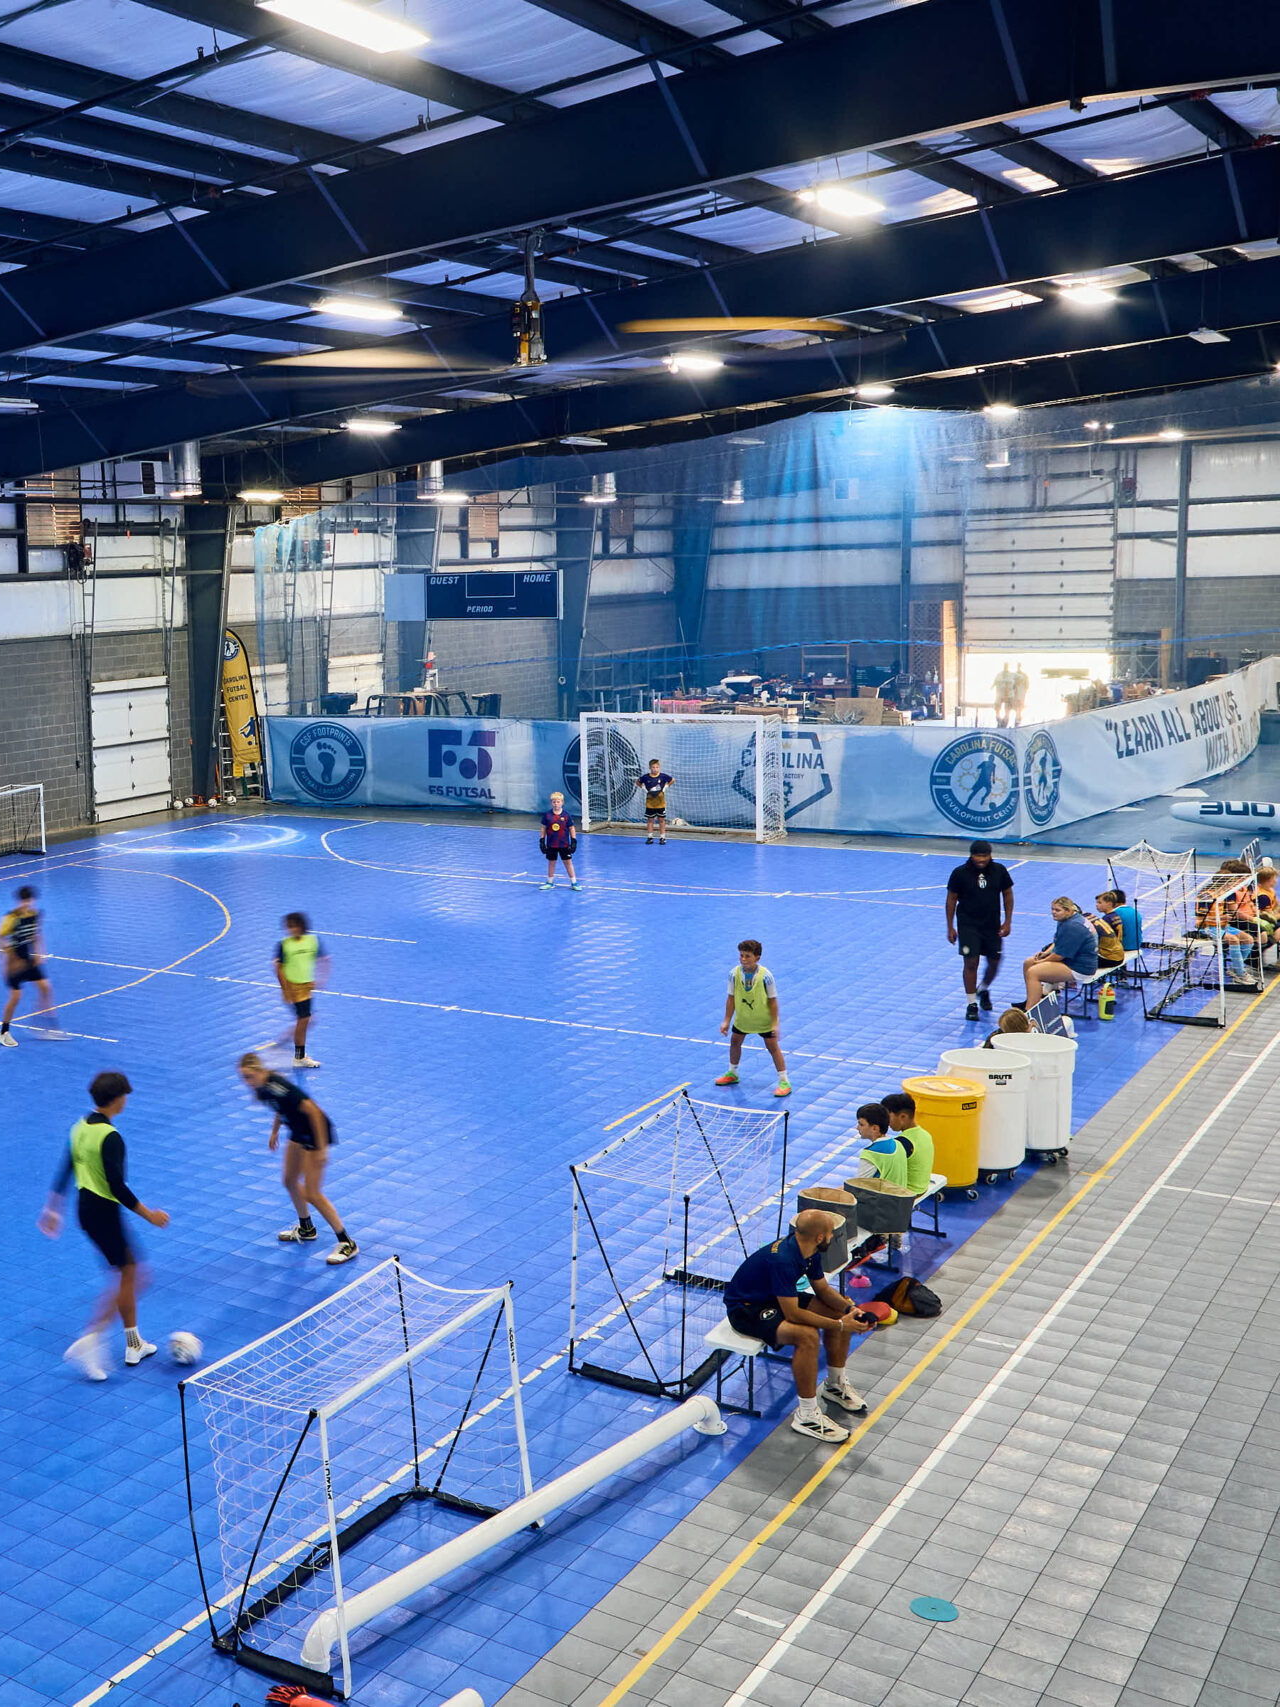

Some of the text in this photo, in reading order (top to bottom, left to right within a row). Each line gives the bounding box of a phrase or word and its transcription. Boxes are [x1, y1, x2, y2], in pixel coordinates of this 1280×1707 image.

[430, 576, 460, 585] GUEST
[523, 573, 551, 583] HOME
[467, 605, 493, 613] PERIOD
[226, 685, 247, 693] FUTSAL
[228, 694, 249, 703] CENTER
[1161, 707, 1191, 746] ALL
[1190, 695, 1224, 738] ABOUT
[300, 727, 353, 746] CSF FOOTPRINTS
[945, 739, 987, 765] CAROLINA
[446, 785, 496, 799] FUTSAL
[943, 793, 992, 822] DEVELOPMENT
